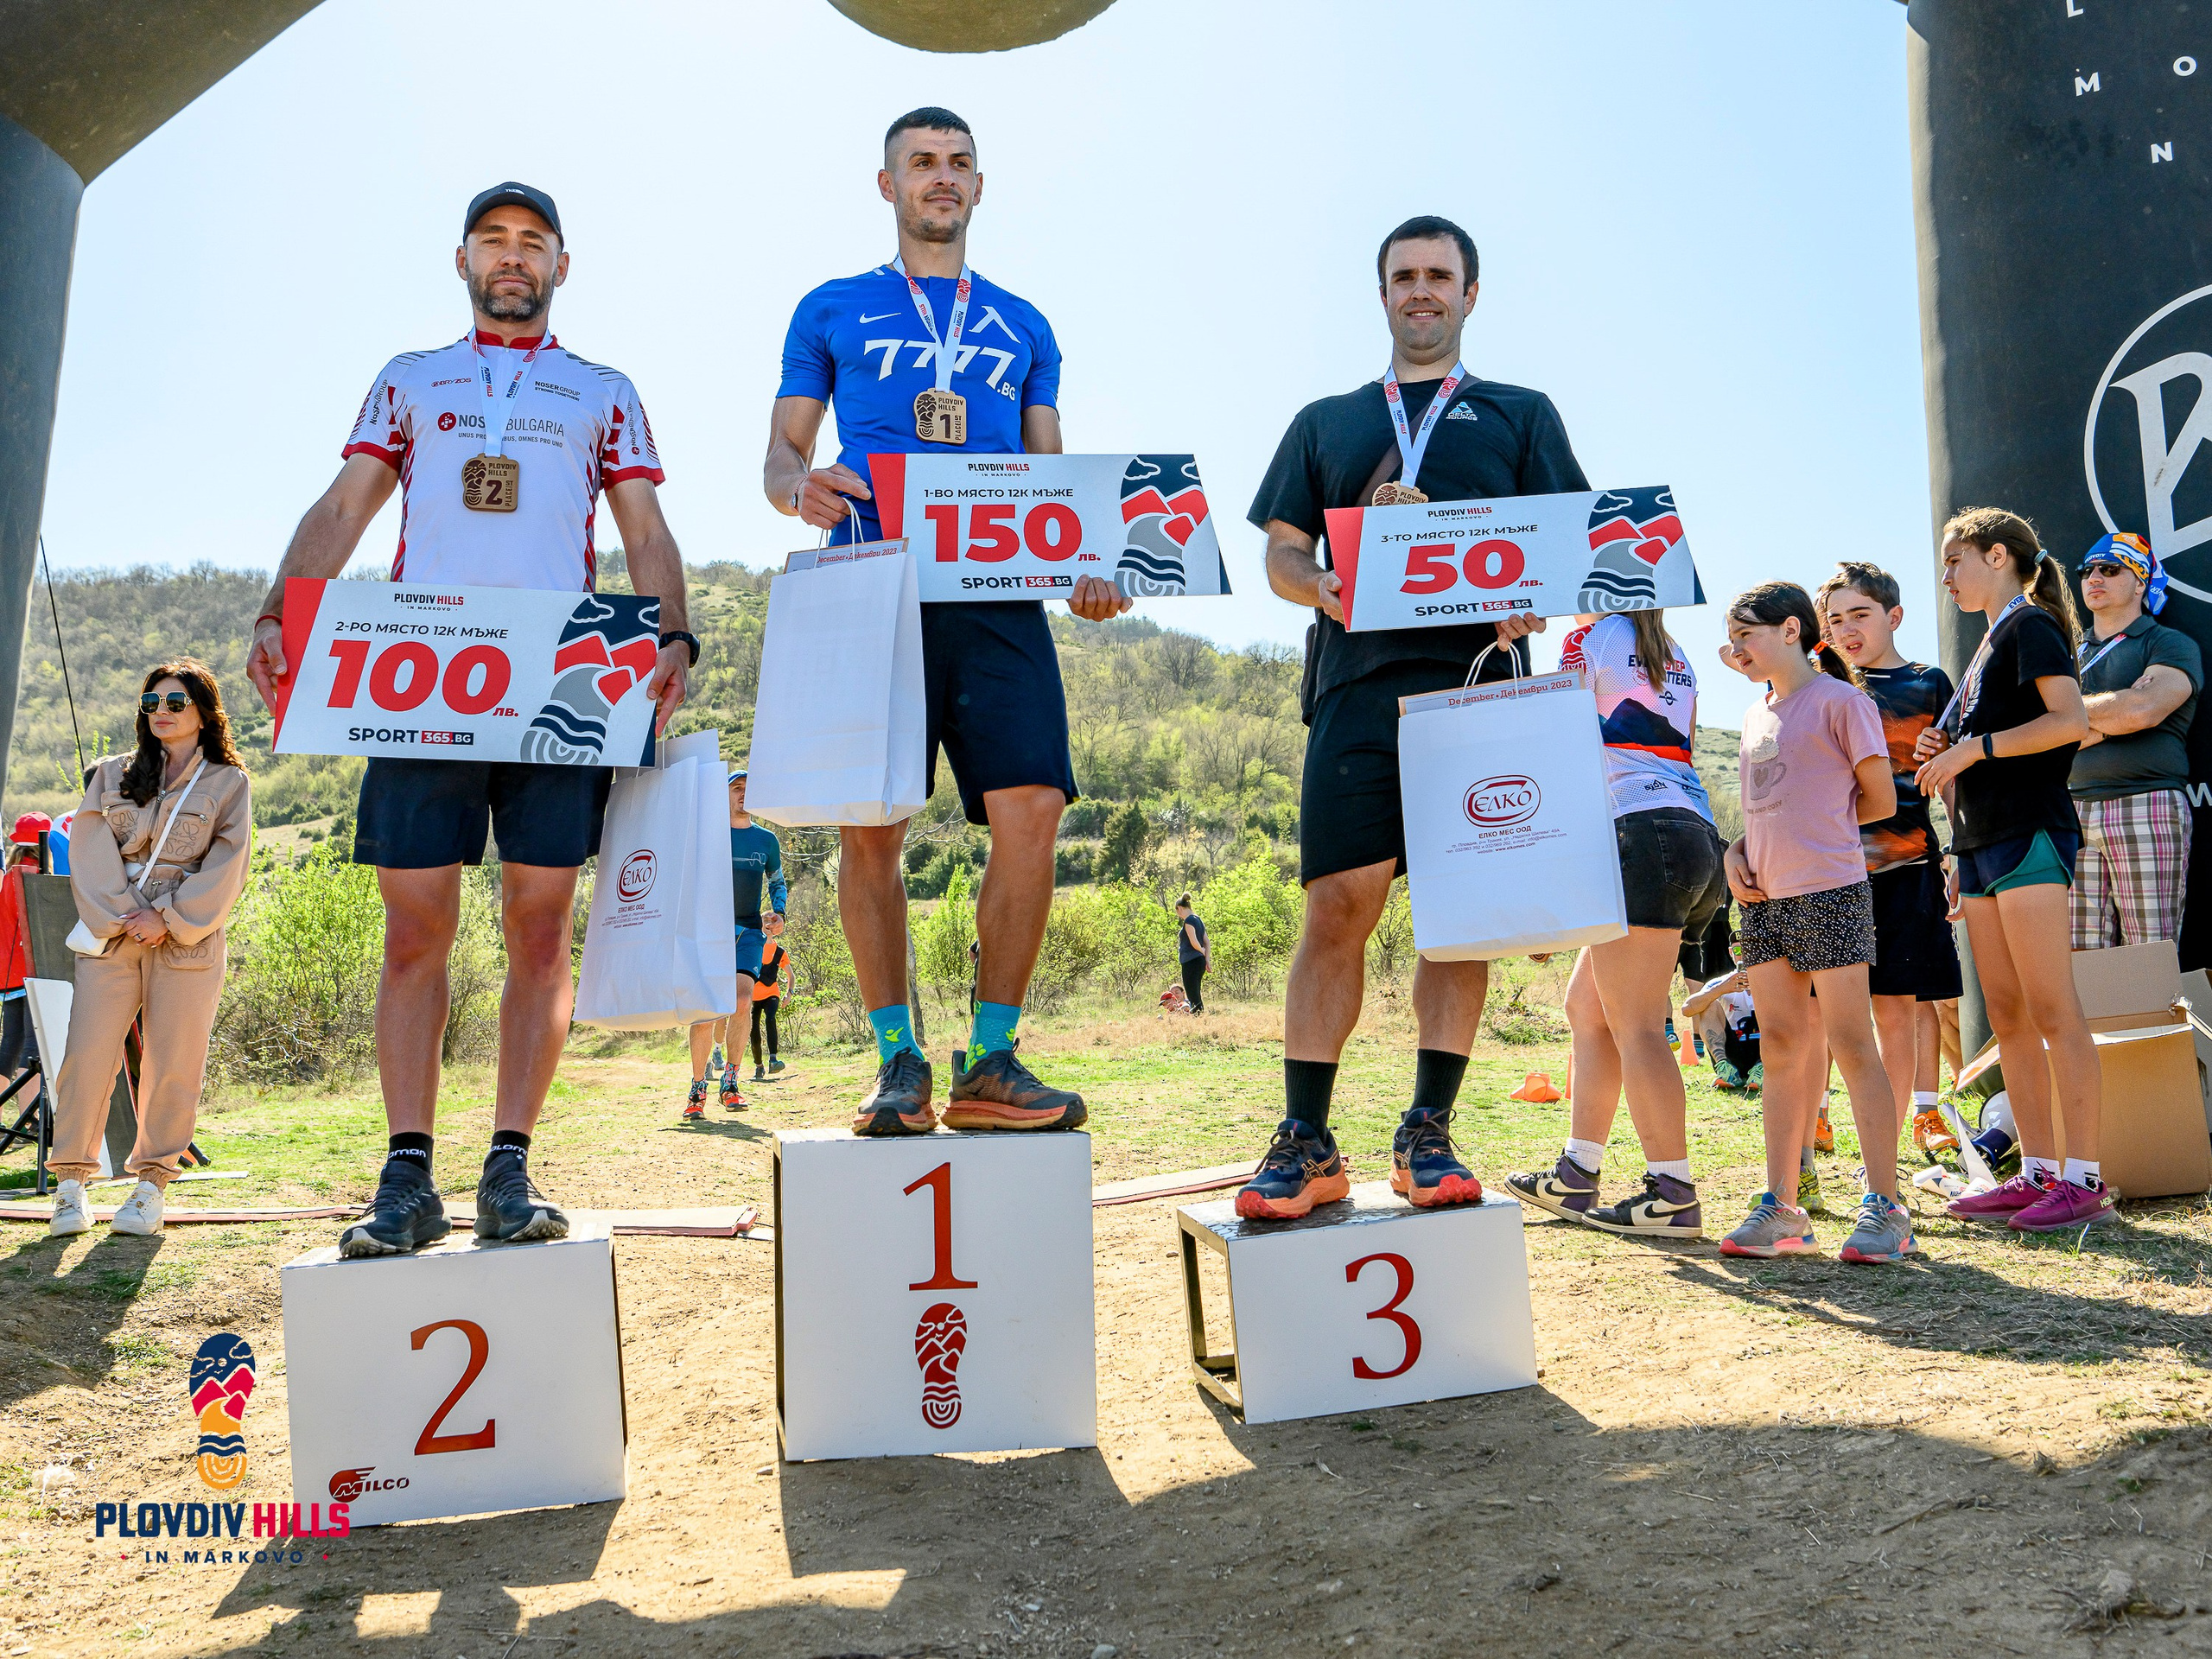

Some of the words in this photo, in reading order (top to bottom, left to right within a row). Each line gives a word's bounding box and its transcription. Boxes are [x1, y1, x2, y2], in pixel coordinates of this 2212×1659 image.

[2075, 72, 2101, 97] M
[2150, 141, 2174, 164] N
[938, 397, 964, 405] PLOVDIV
[458, 414, 486, 429] NOS
[505, 417, 565, 437] BULGARIA
[939, 413, 951, 439] 1
[551, 440, 563, 448] UNO
[968, 463, 1005, 472] PLOVDIV
[1005, 463, 1030, 472] HILLS
[485, 480, 503, 505] 2
[957, 489, 1005, 498] МЯСТО
[1033, 488, 1074, 498] МЪЖЕ
[1400, 491, 1426, 503] PLOVDIV
[1427, 508, 1466, 518] PLOVDIV
[1467, 506, 1492, 515] HILLS
[925, 502, 1083, 563] 150
[1415, 530, 1465, 541] МЯСТО
[1494, 524, 1539, 535] МЪЖЕ
[881, 547, 898, 556] 2023
[1399, 539, 1525, 595] 50
[961, 575, 1022, 590] SPORT
[394, 593, 436, 604] PLOVDIV
[436, 595, 464, 606] HILLS
[1414, 602, 1480, 617] SPORT
[375, 623, 429, 635] МЯСТО
[460, 627, 509, 639] МЪЖЕ
[327, 639, 512, 715] 100
[1550, 679, 1573, 690] 2023
[348, 727, 420, 743] SPORT
[1478, 830, 1498, 839] ЕЛКО
[1516, 825, 1532, 834] ООД
[902, 1161, 978, 1291] 1
[1344, 1252, 1422, 1381] 3
[410, 1319, 496, 1456] 2
[333, 1477, 410, 1499] MILCO
